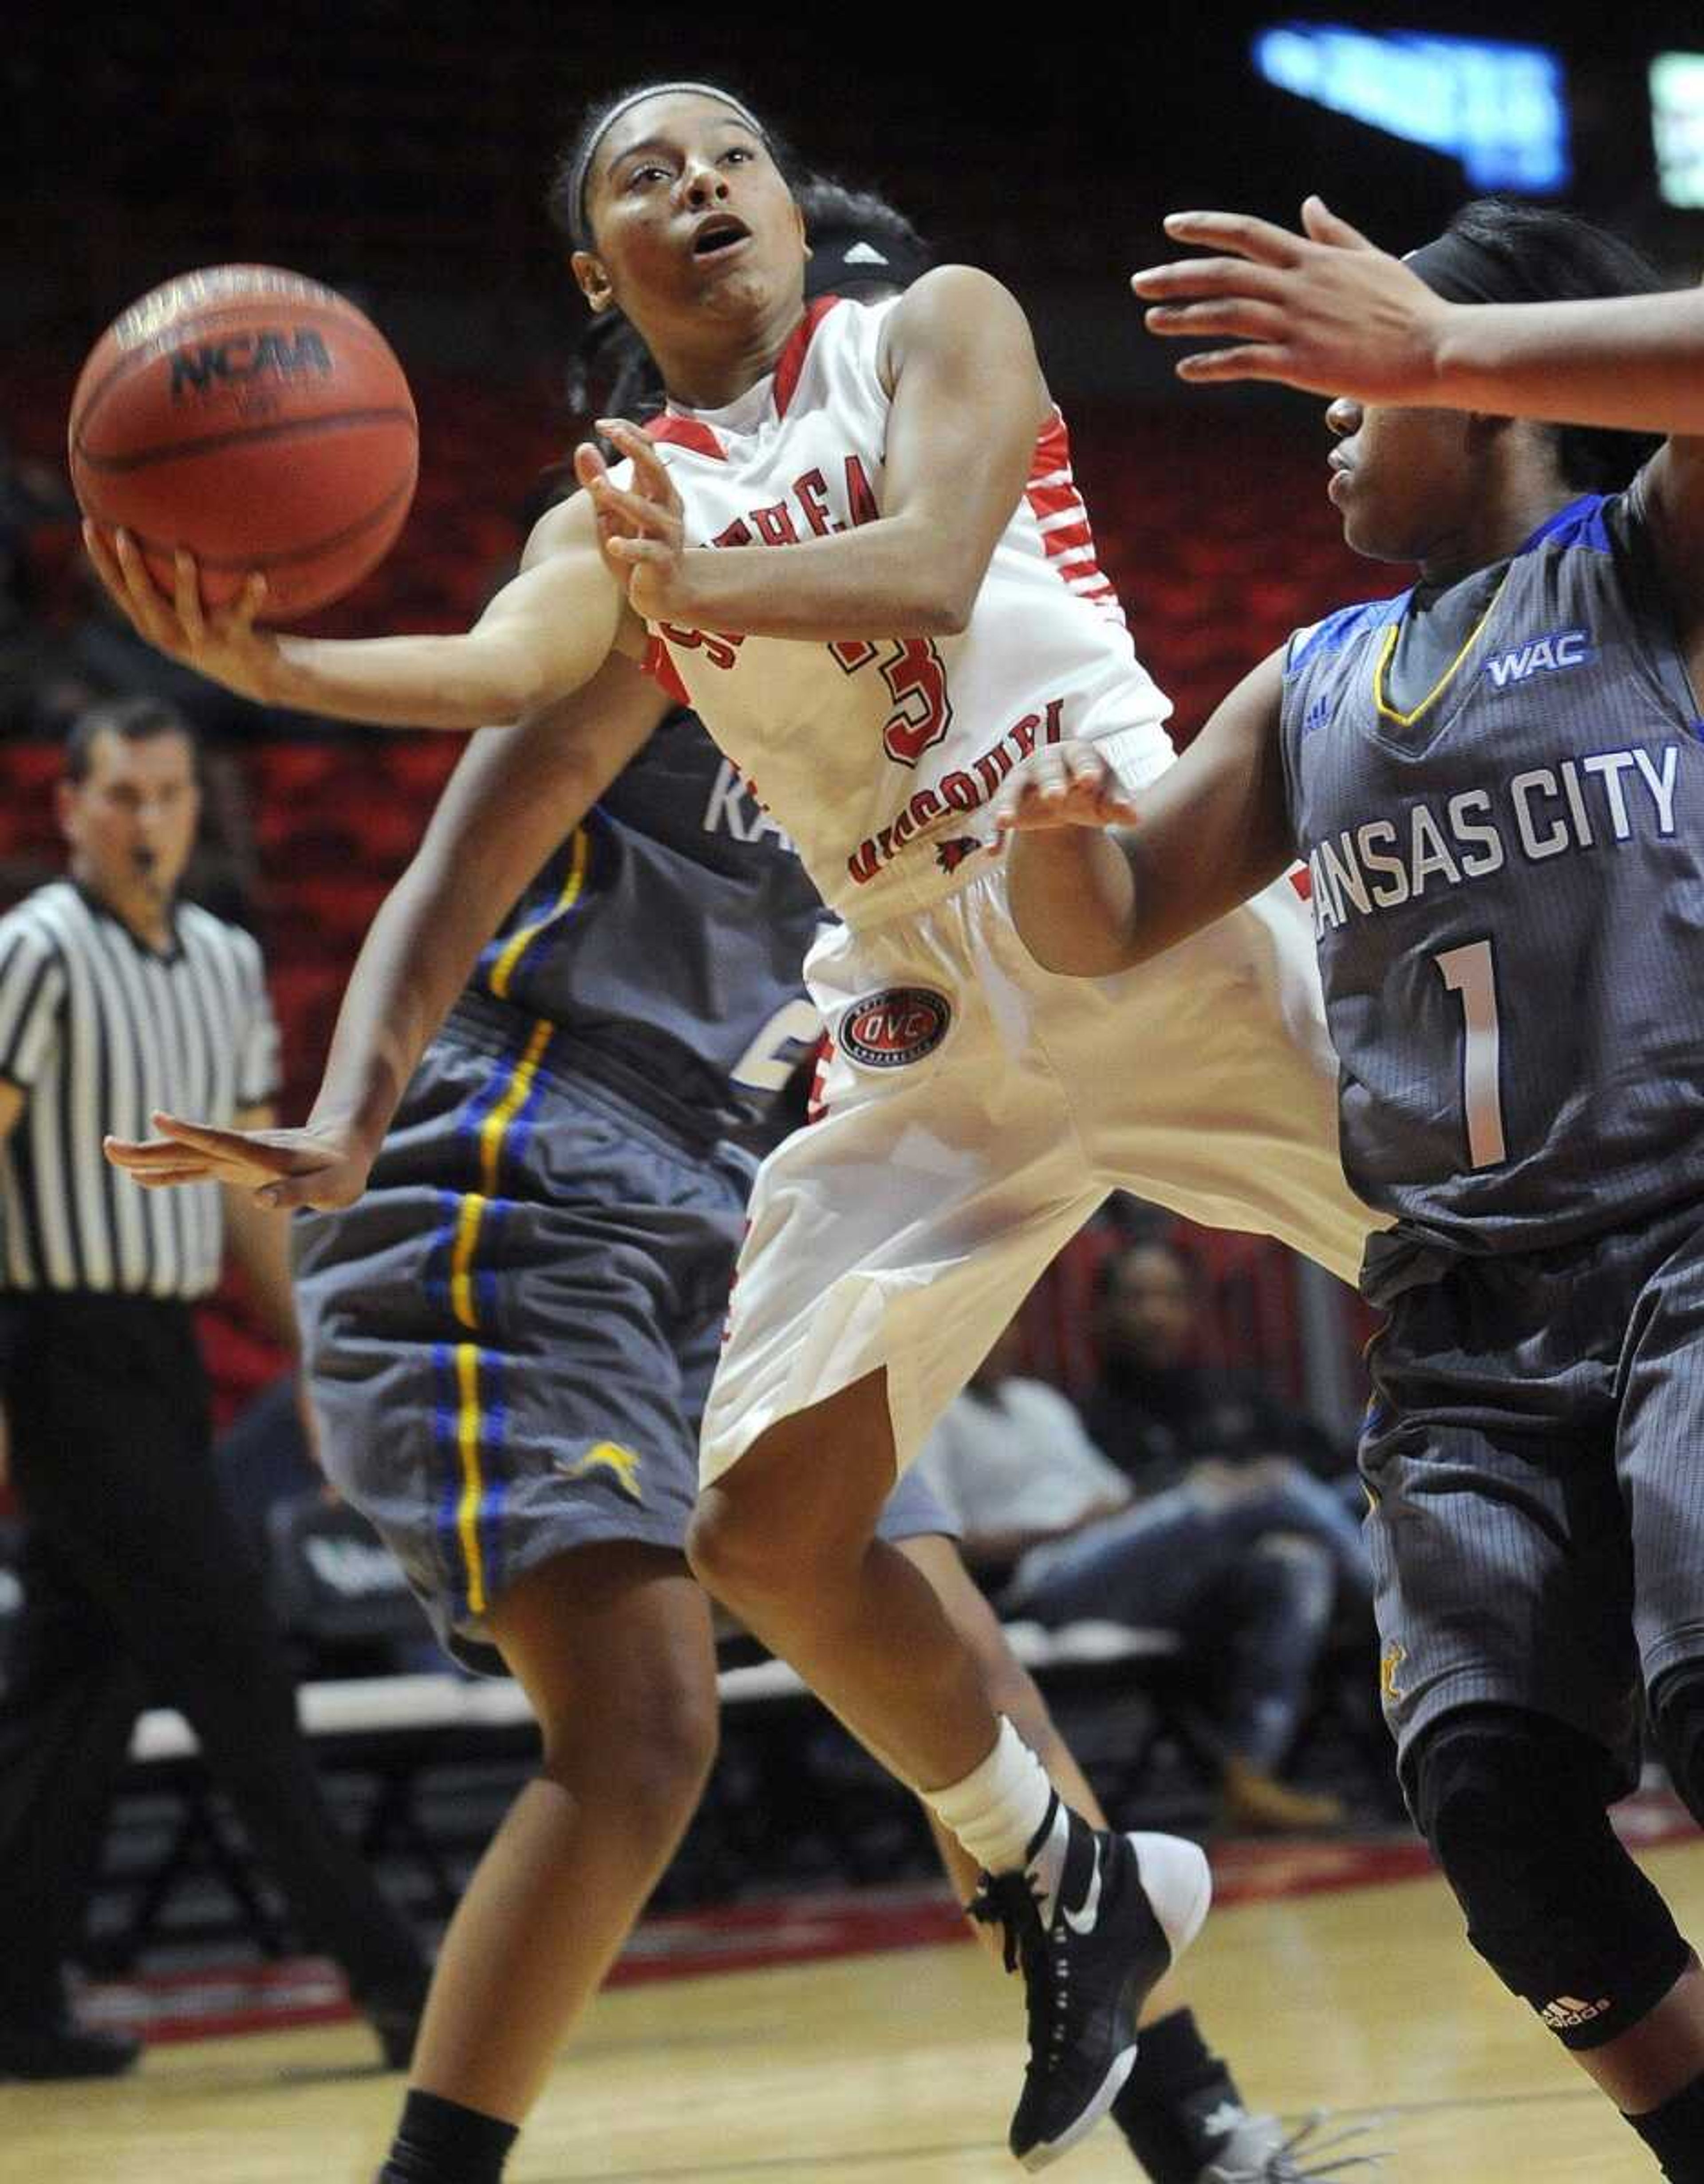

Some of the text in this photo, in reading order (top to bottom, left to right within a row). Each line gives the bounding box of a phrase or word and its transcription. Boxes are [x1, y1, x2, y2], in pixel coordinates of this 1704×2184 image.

[170, 327, 332, 403] NCAA
[1486, 634, 1584, 686] WAC
[1310, 746, 1678, 942] ANSAS CITY
[864, 1012, 924, 1041] OVC
[1433, 939, 1507, 1169] 1
